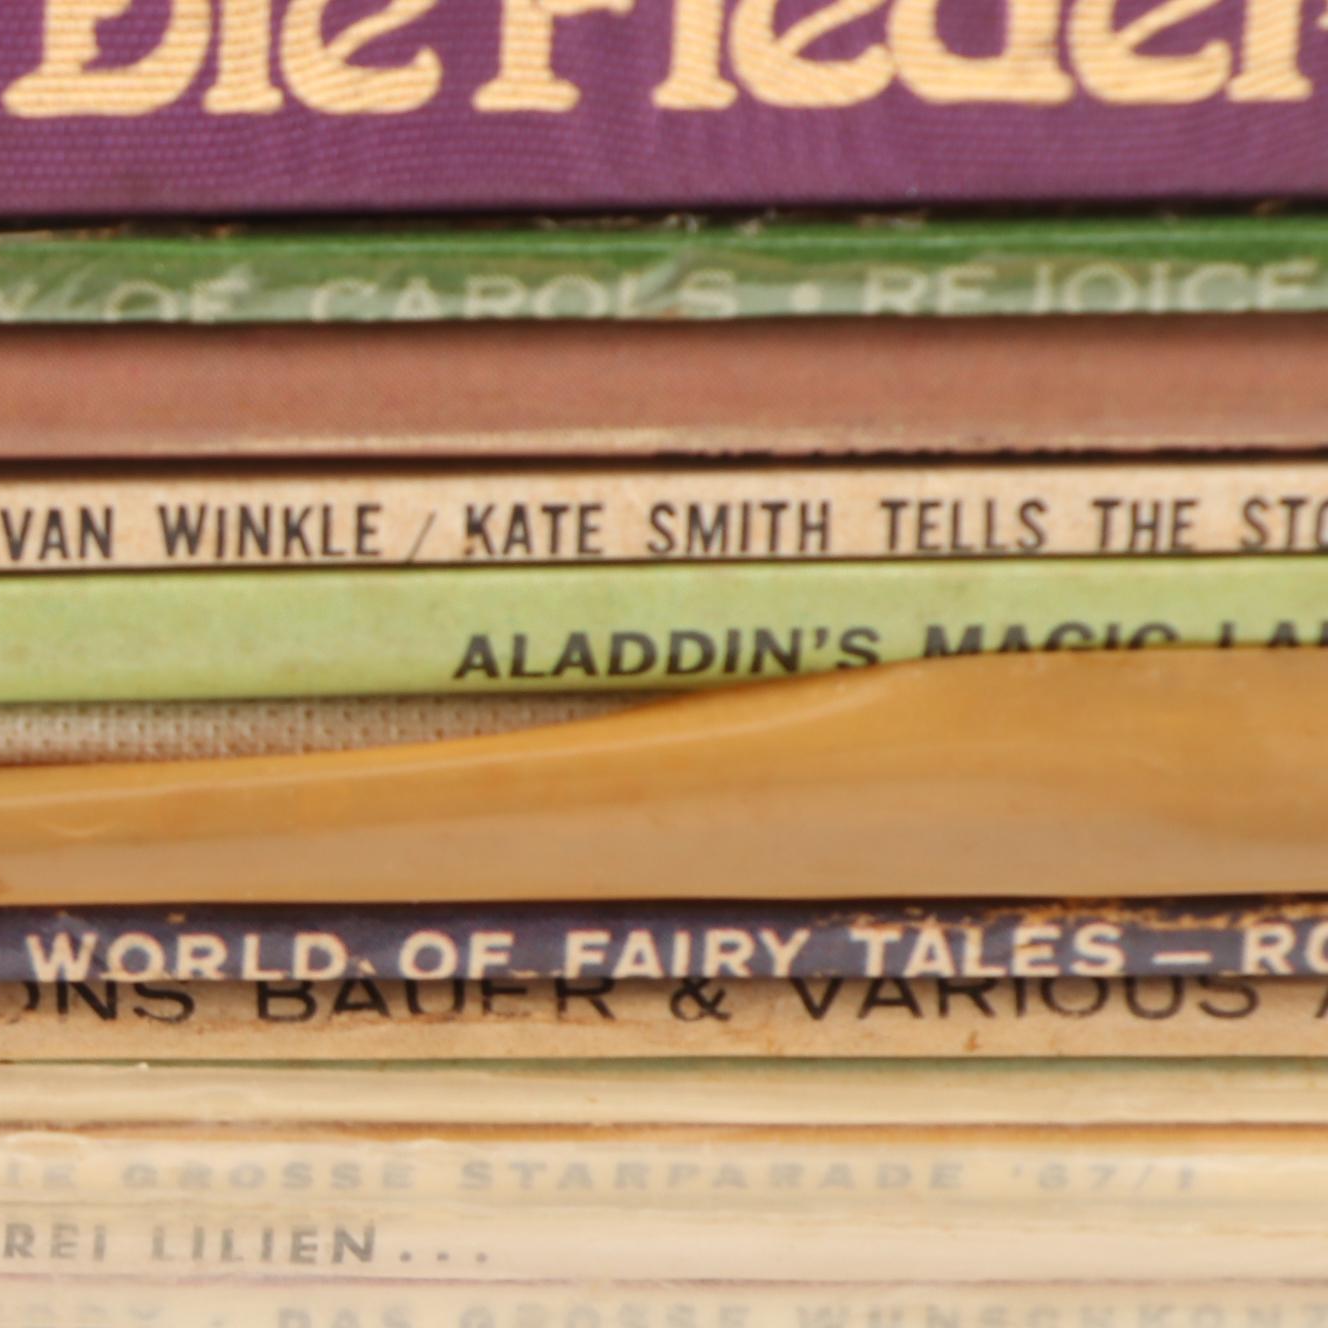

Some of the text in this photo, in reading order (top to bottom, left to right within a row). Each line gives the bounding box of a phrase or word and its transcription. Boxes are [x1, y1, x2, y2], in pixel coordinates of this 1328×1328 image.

[0, 506, 115, 562] VAN
[158, 504, 383, 560] WINKLE
[463, 503, 605, 558] KATE
[646, 500, 831, 556] SMITH
[880, 499, 1050, 555] TELLS
[1091, 497, 1200, 554] THE
[452, 624, 883, 681] ALADDIN'S
[25, 932, 349, 983] WORLD
[396, 929, 517, 981] OF
[563, 926, 812, 979] FAIRY
[848, 922, 1128, 977] TALES
